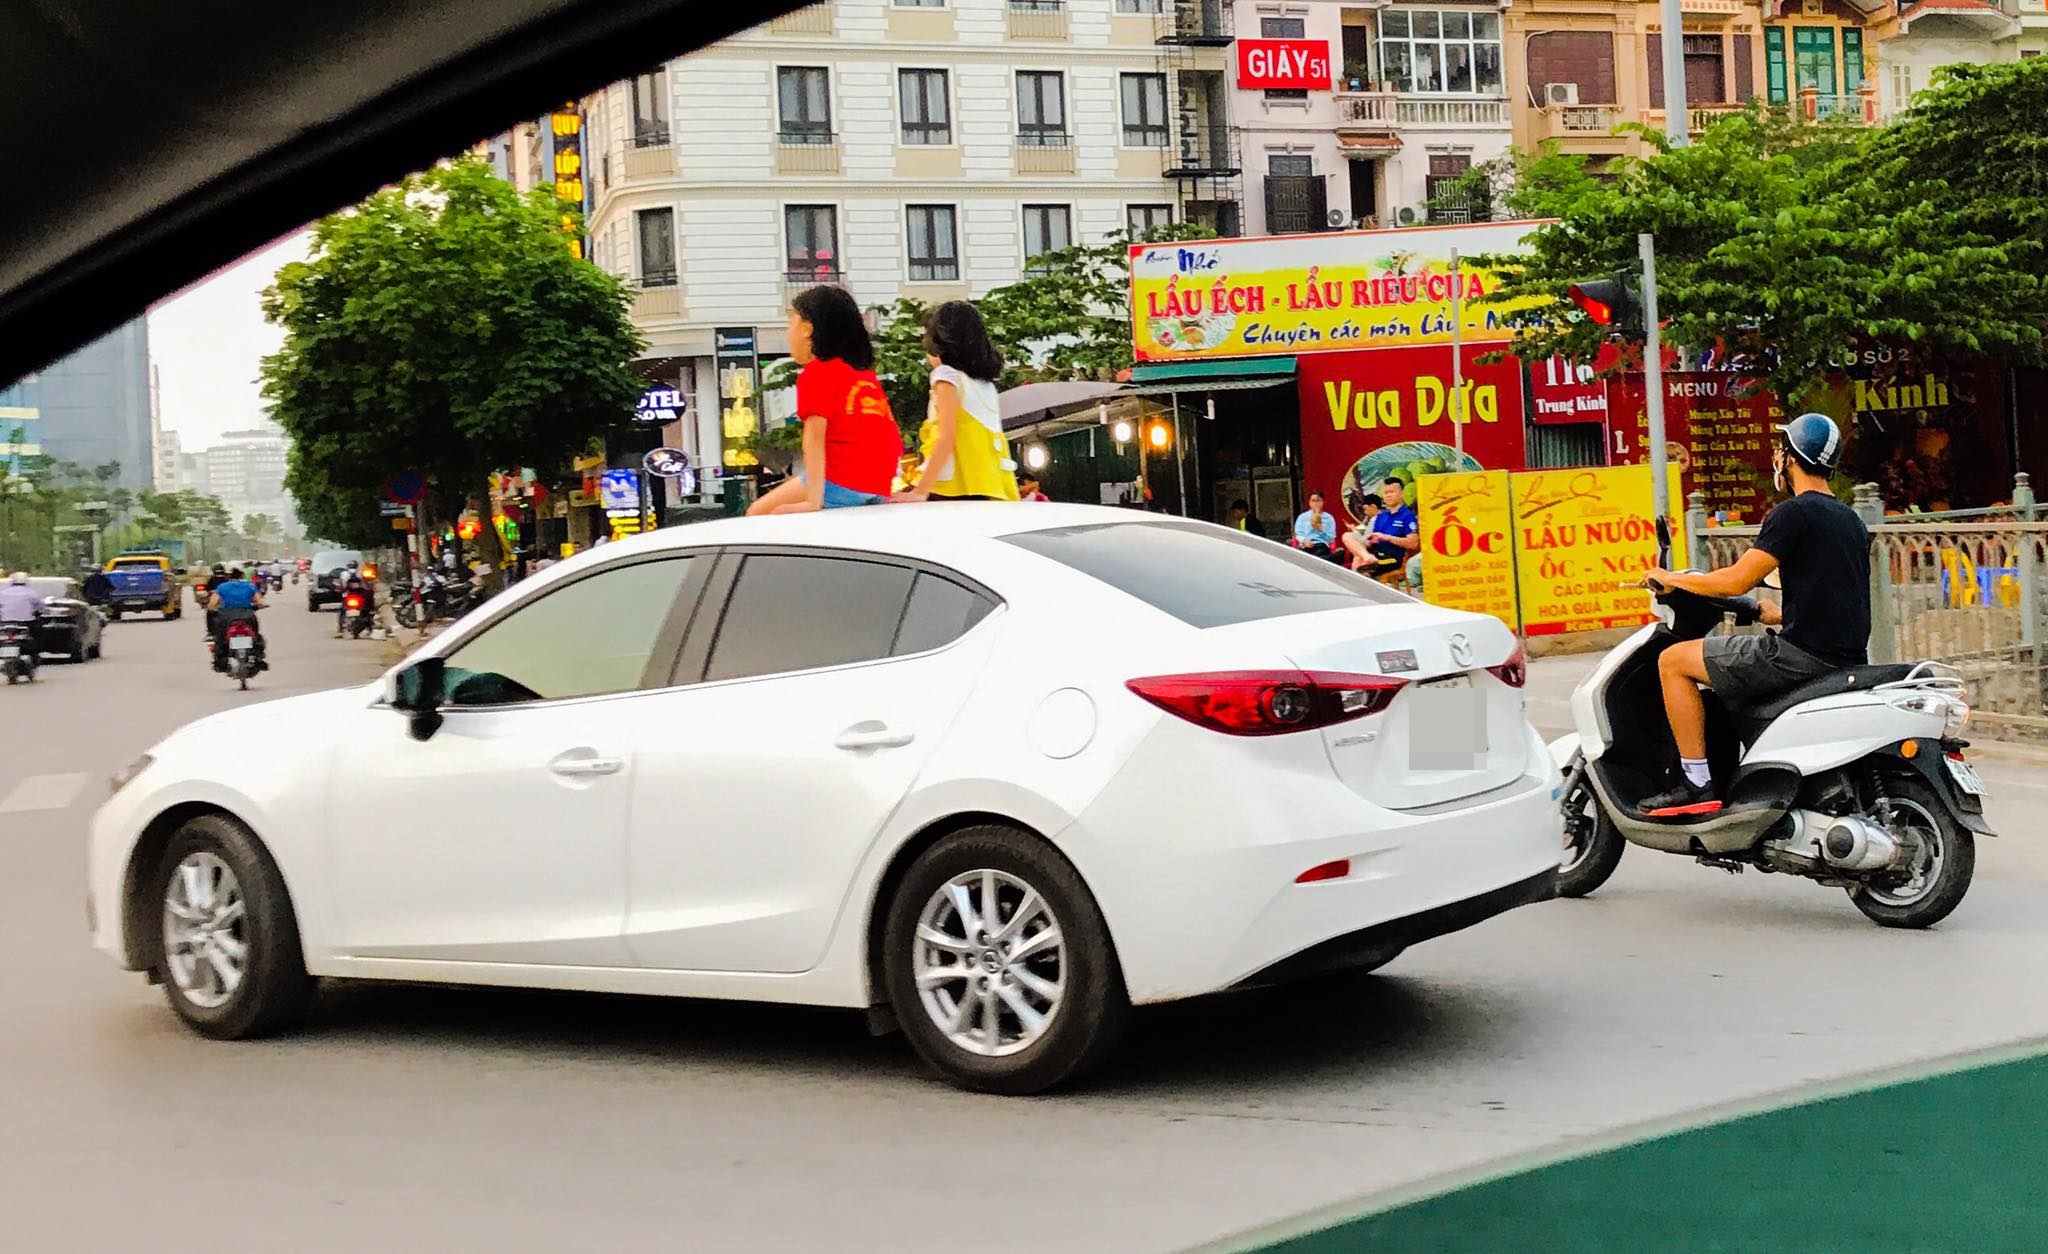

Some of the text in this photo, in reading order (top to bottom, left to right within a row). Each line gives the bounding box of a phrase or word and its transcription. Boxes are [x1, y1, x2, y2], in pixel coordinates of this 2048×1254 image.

[1311, 58, 1327, 78] 51
[1148, 274, 1203, 319] LẨU
[1211, 274, 1265, 315] ẾCH
[1287, 265, 1343, 310] LẨU
[1243, 322, 1321, 346] Chuyên
[1330, 319, 1360, 339] các
[1370, 317, 1410, 337] món
[1897, 348, 1909, 361] 2
[1669, 382, 1717, 397] MENU
[1853, 373, 1949, 412] Kính
[1324, 380, 1400, 430] Vua
[1536, 395, 1607, 416] Trung Kính
[1432, 506, 1505, 557] Ốc
[1523, 514, 1577, 549] LẨU
[1540, 552, 1575, 580] ỐC
[1554, 580, 1584, 597] CÁC
[1538, 602, 1569, 617] HOA
